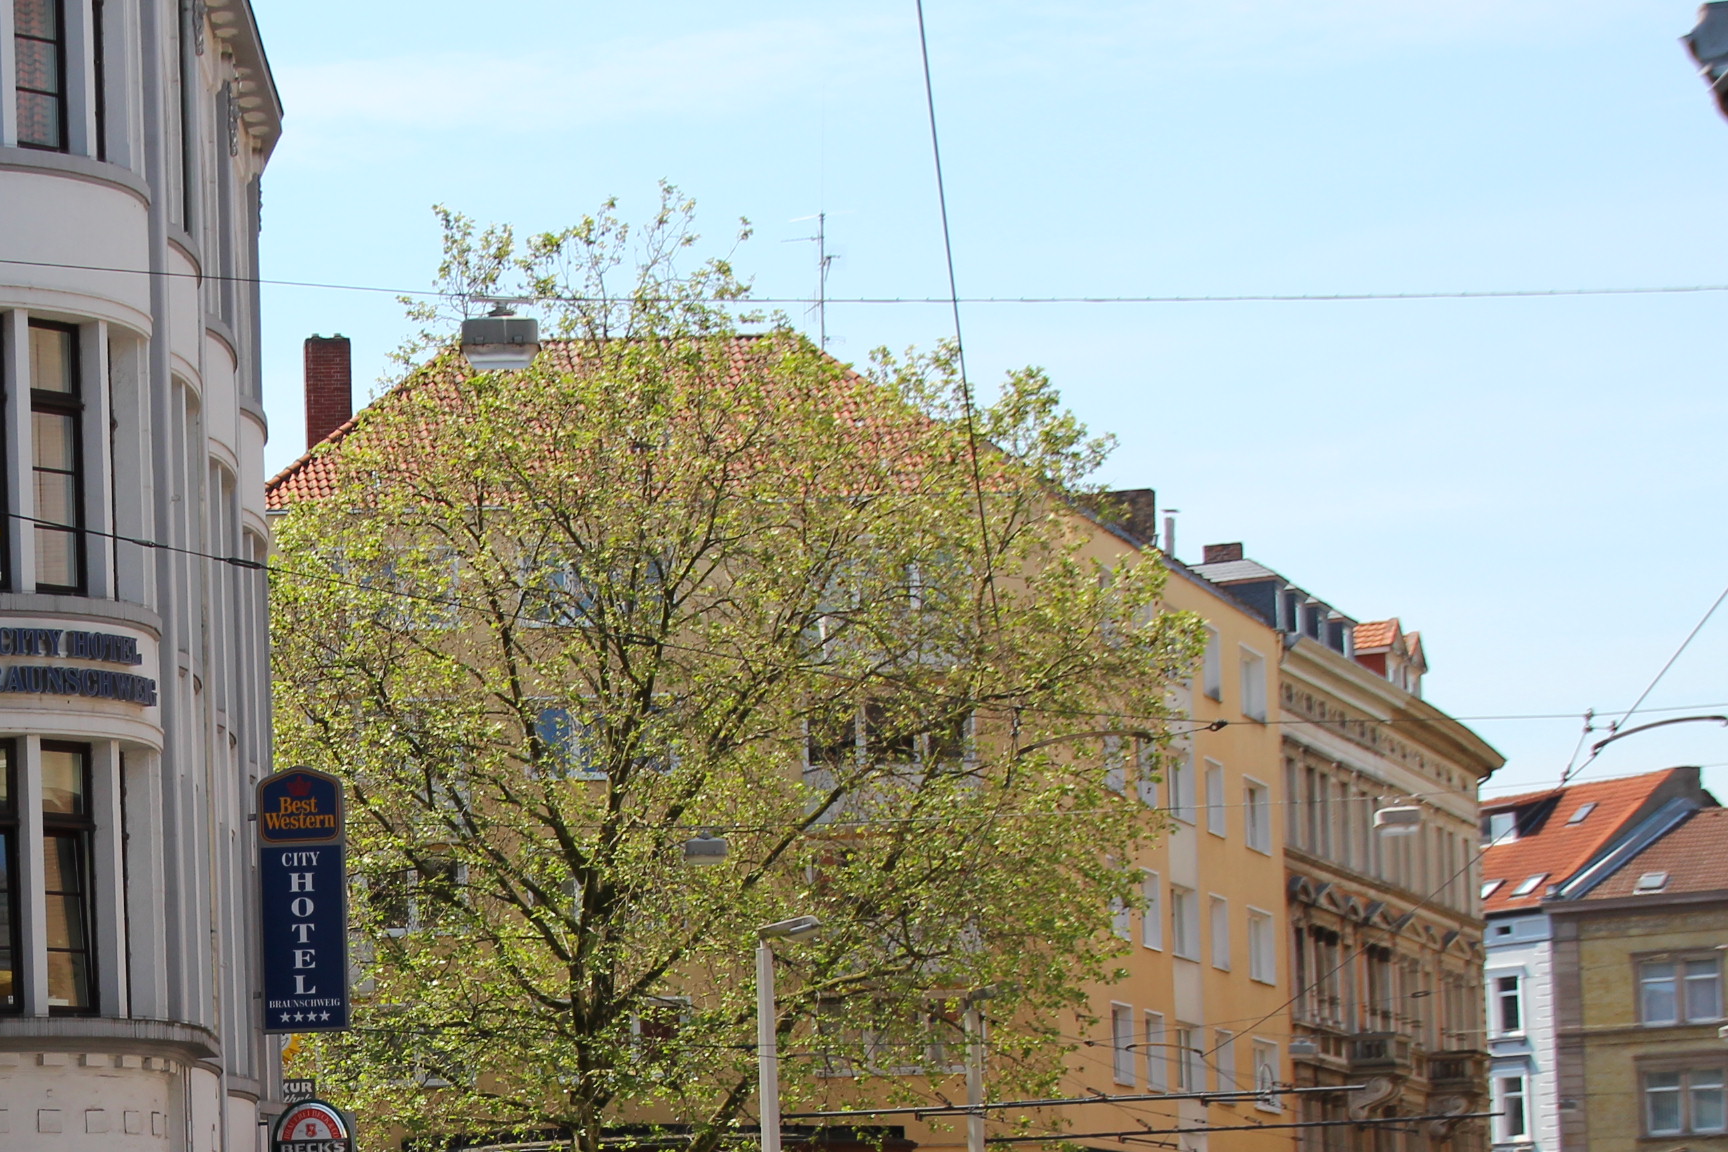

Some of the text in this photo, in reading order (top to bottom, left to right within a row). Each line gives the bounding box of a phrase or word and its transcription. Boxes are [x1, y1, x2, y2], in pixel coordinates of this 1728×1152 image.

[68, 631, 142, 665] HOTEL
[279, 796, 318, 815] Best
[265, 810, 336, 830] Western
[281, 851, 320, 867] CITY
[288, 872, 317, 995] HOTEL
[269, 998, 341, 1009] BRAUNSCHWEIG
